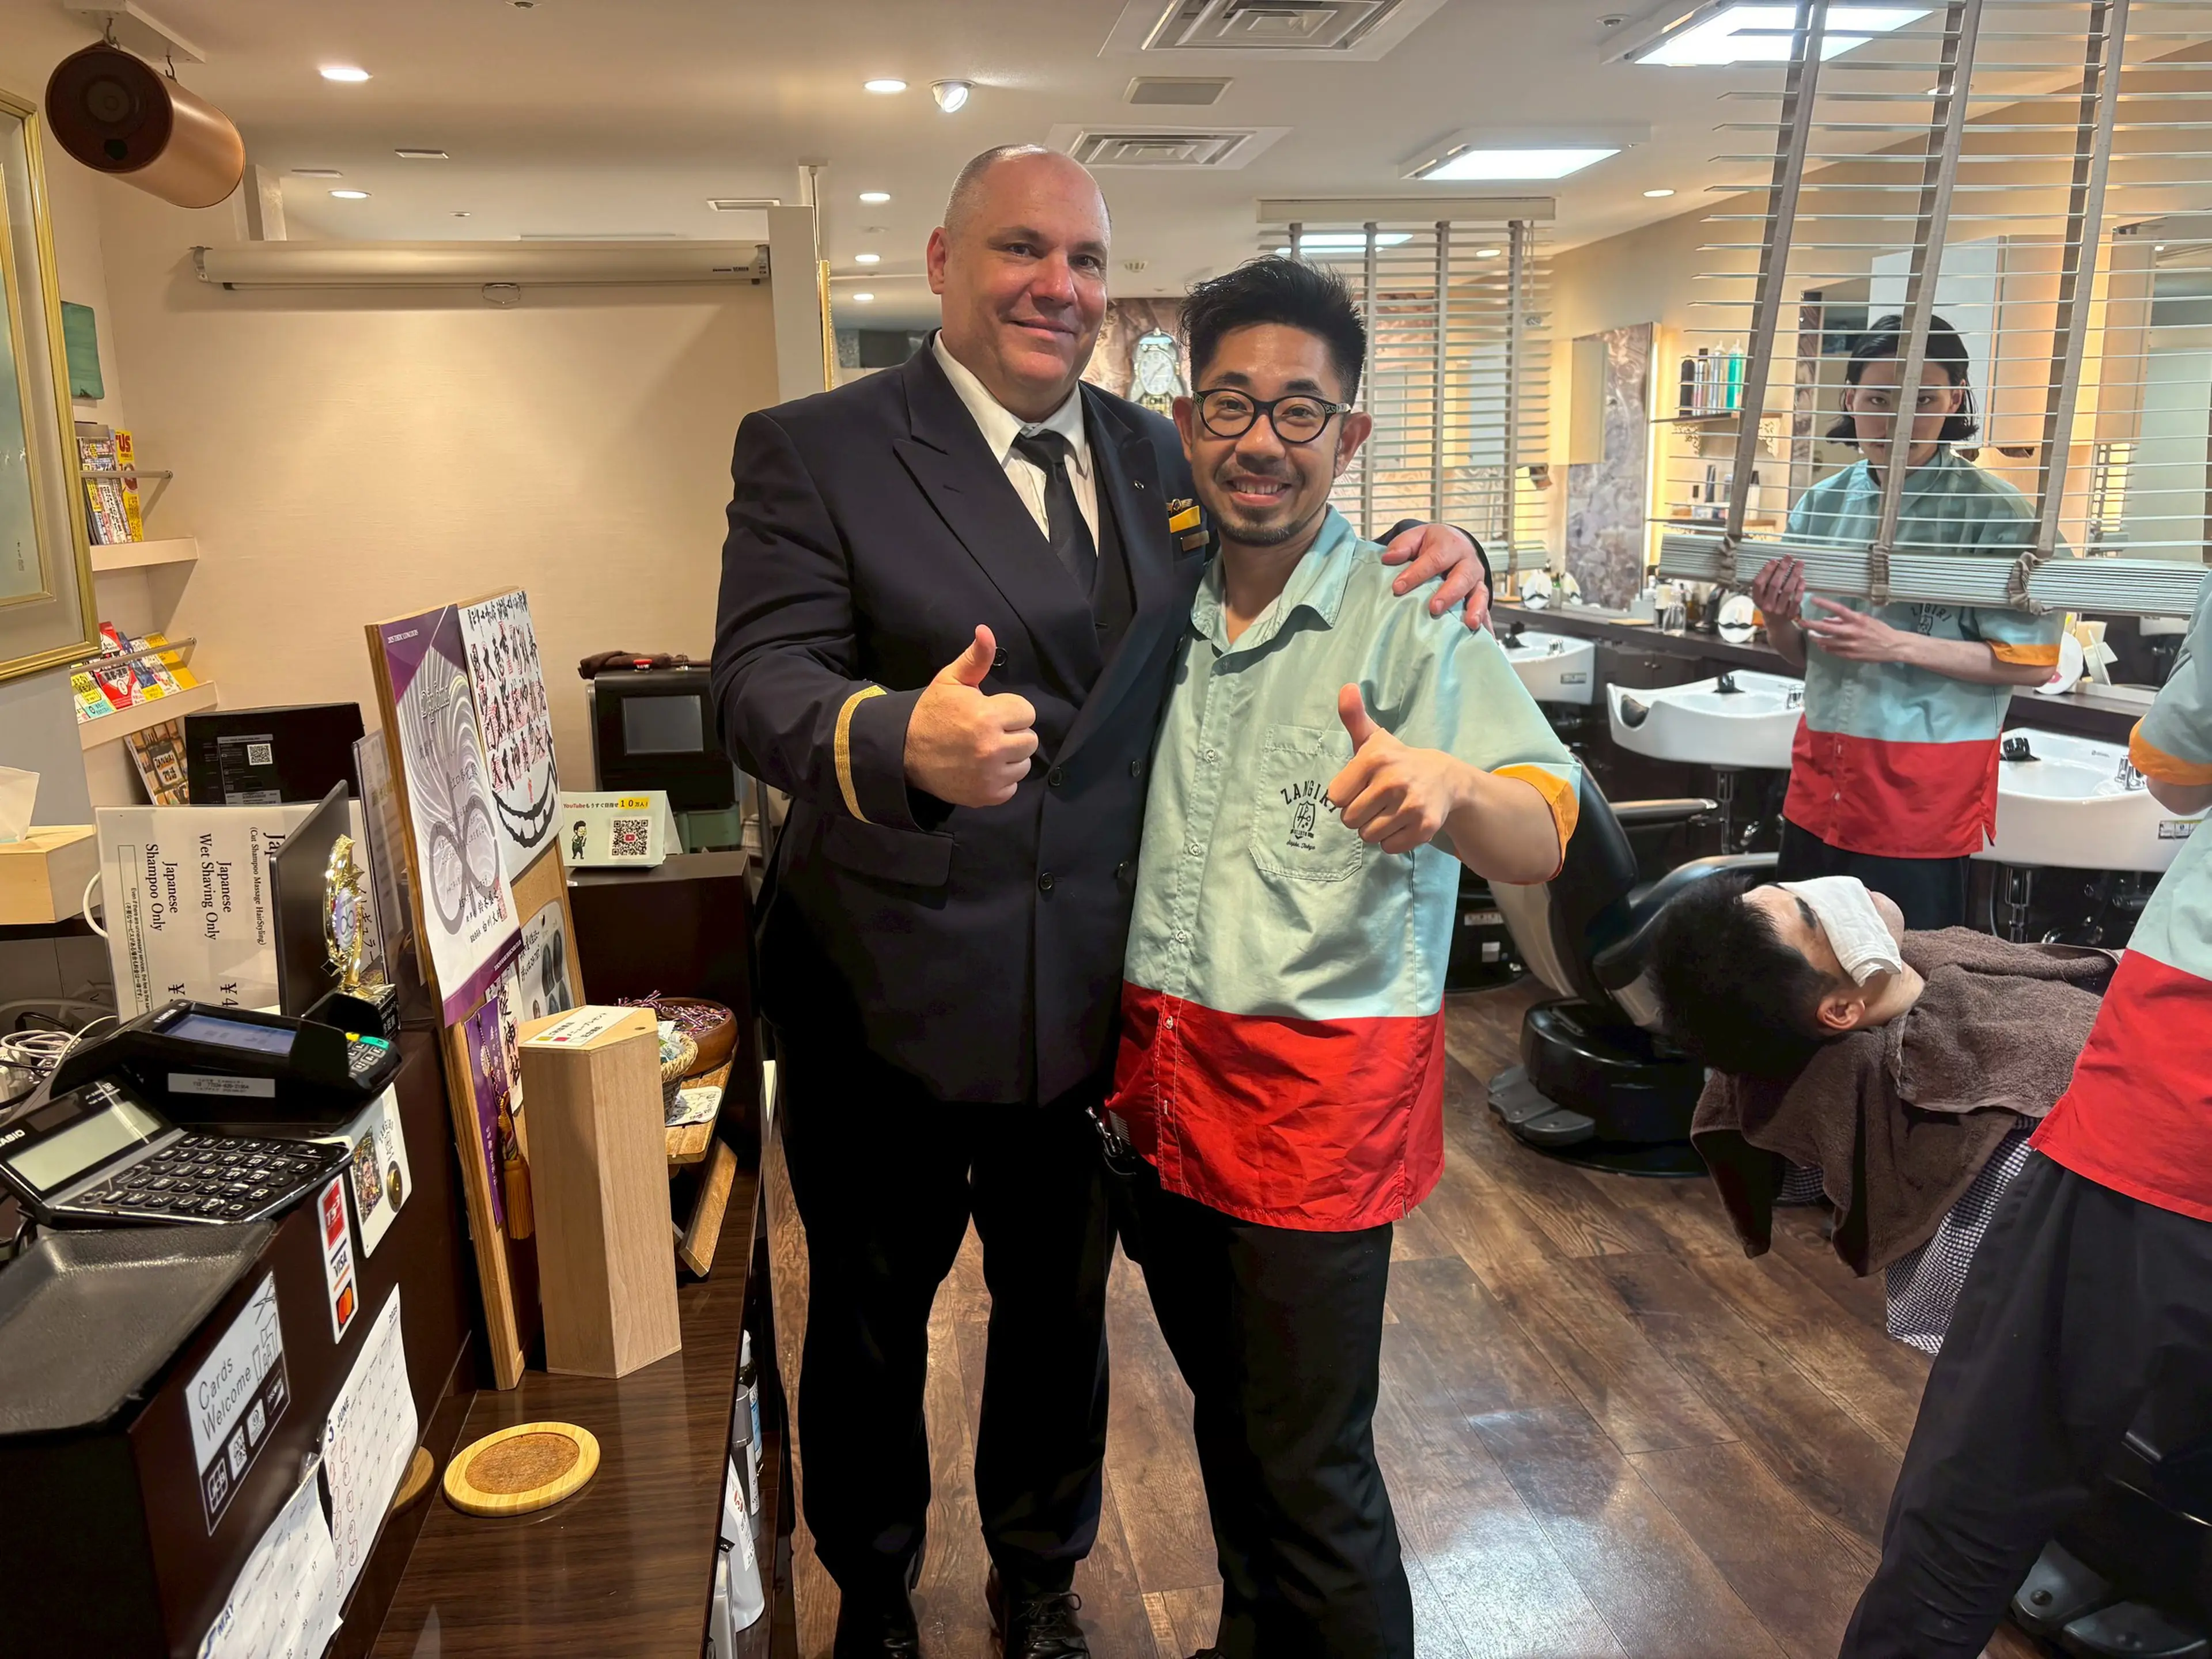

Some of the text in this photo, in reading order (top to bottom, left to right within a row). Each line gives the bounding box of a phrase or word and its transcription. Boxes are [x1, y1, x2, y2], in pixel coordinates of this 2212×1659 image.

[251, 842, 259, 874] Shampoo
[145, 843, 166, 931] Shampoo Only
[162, 861, 179, 914] Japanese
[199, 833, 221, 940] Wet Shaving Only
[216, 861, 232, 913] Japanese
[253, 876, 261, 904] Massage
[0, 1129, 25, 1147] ASIO
[333, 1251, 347, 1278] VISA
[199, 1357, 233, 1410] Cards
[202, 1367, 251, 1441] Welcome
[337, 1396, 350, 1428] JUNE
